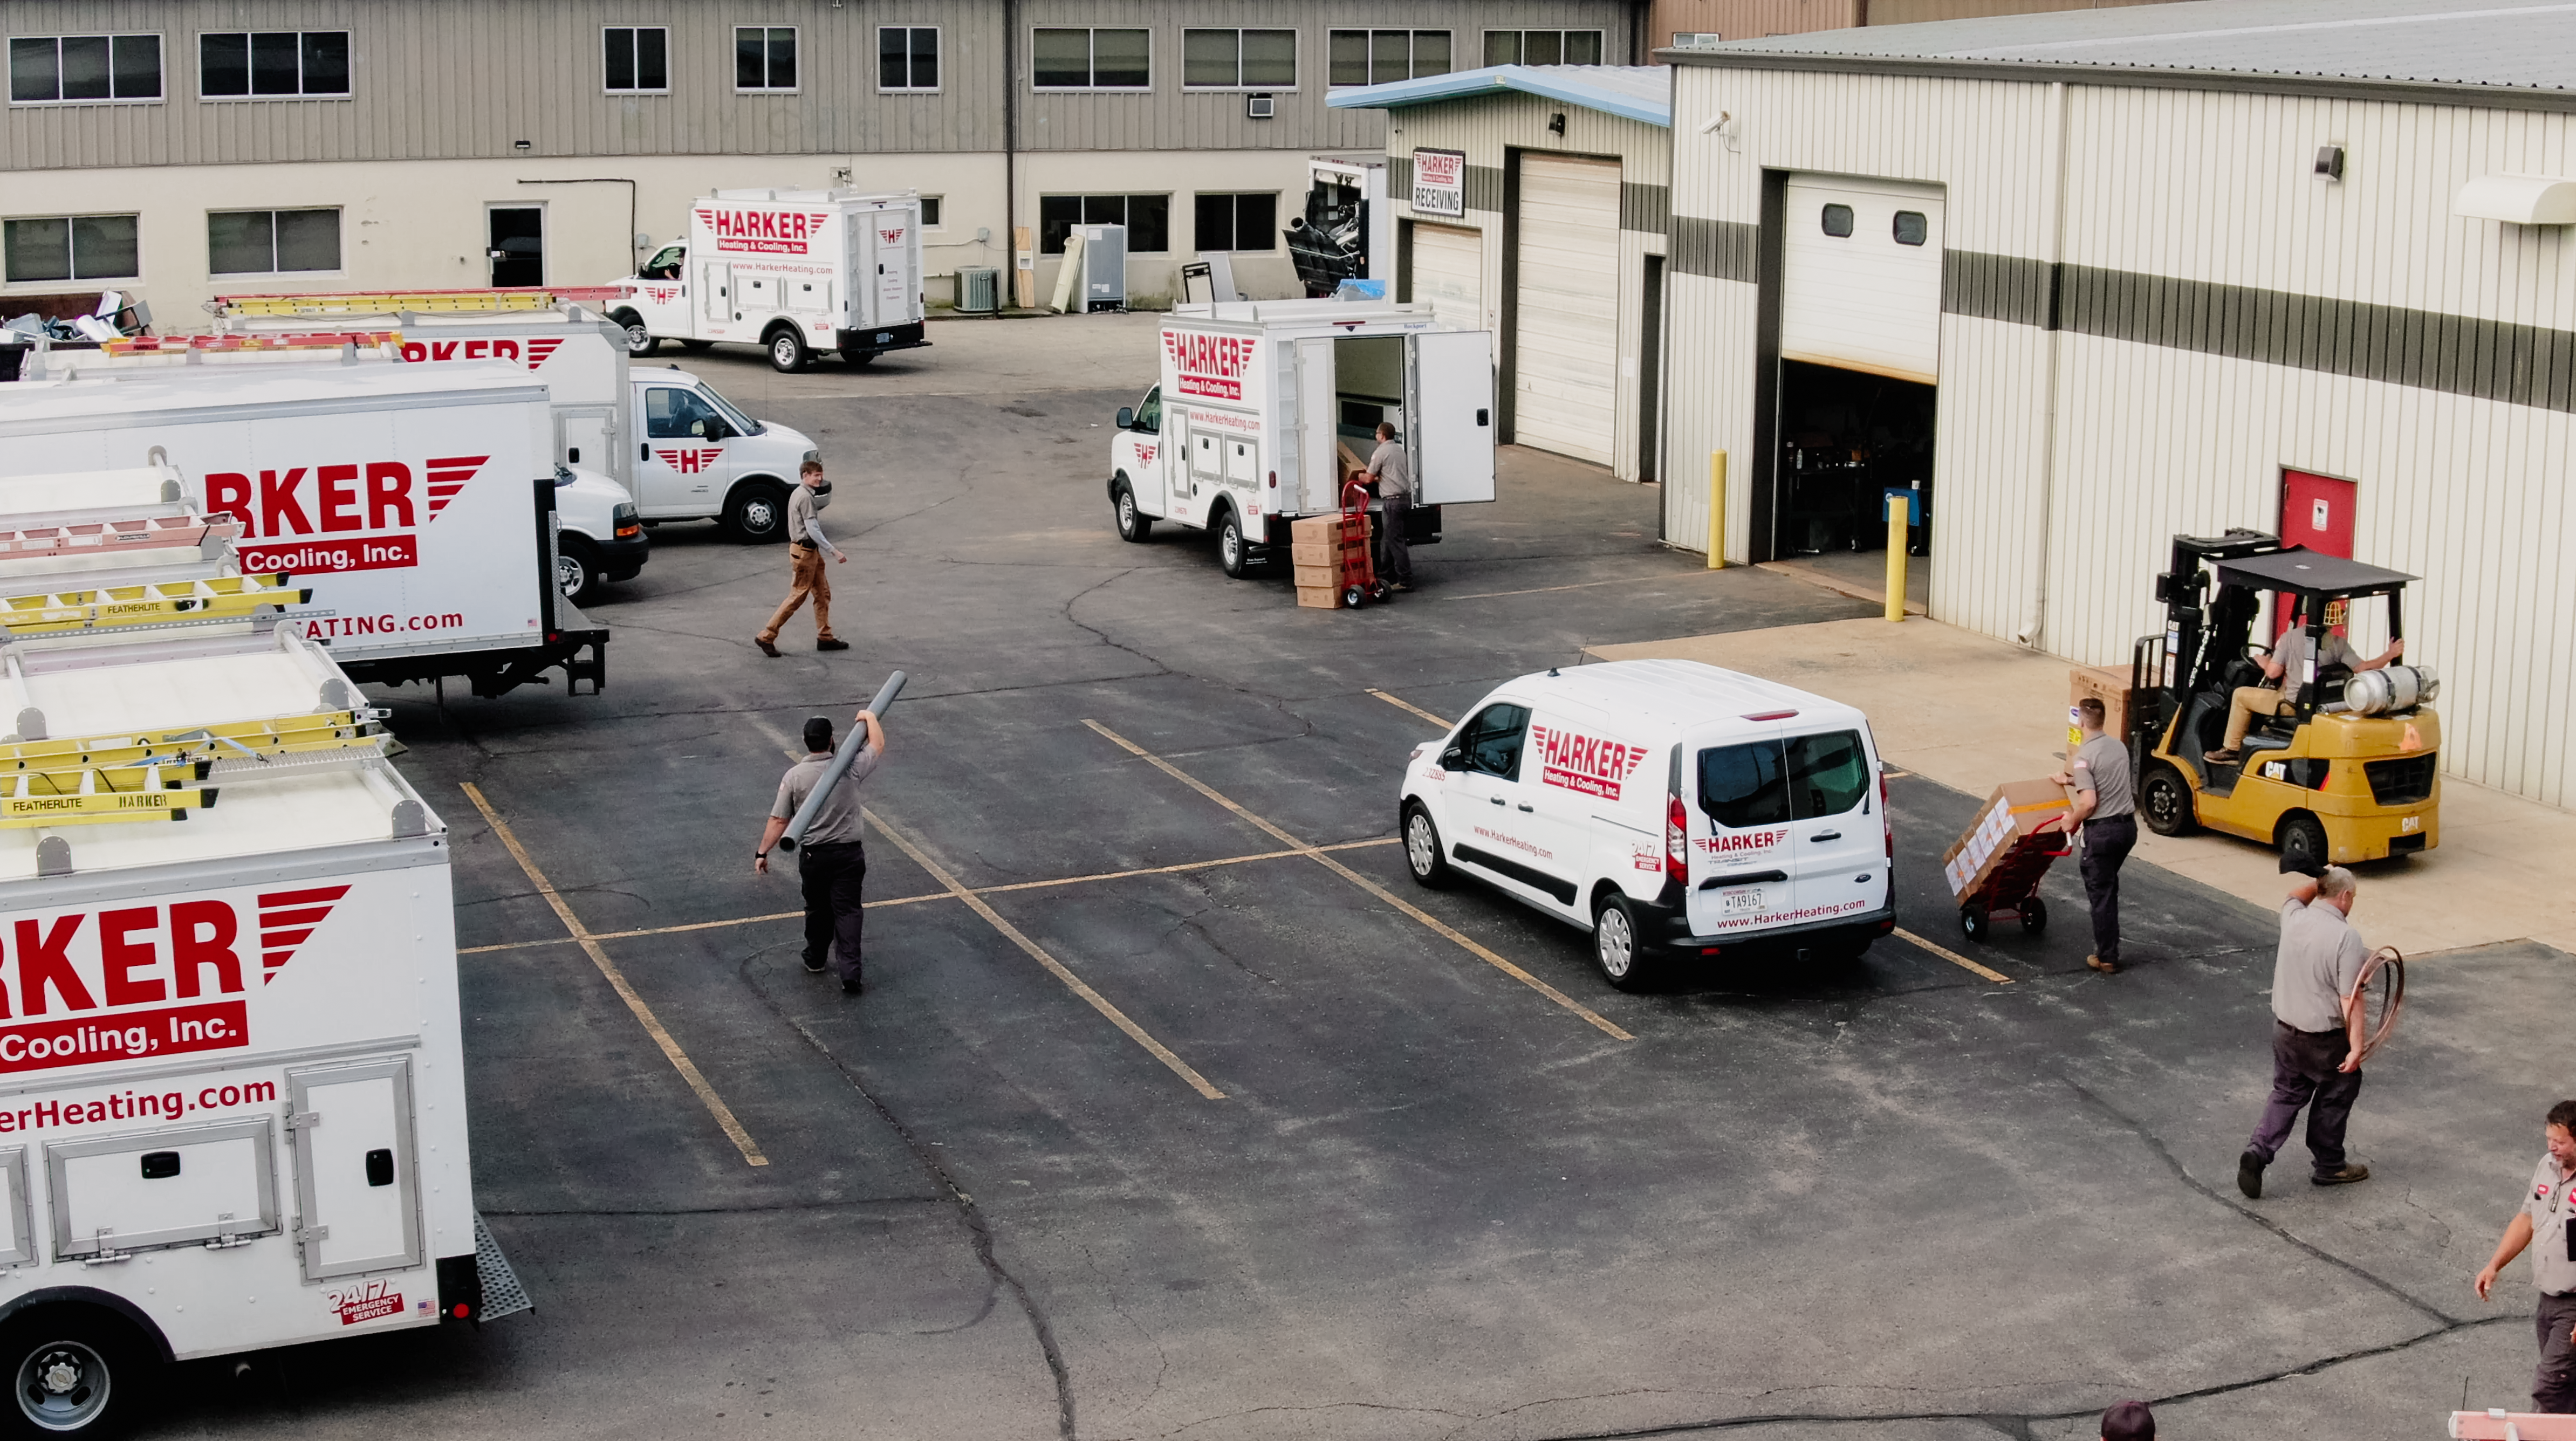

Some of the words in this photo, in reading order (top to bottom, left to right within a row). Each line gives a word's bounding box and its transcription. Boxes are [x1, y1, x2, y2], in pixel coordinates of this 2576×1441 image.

[1422, 154, 1454, 175] HARKER
[1415, 187, 1459, 211] RECEIVING
[716, 210, 807, 239] HARKER
[720, 240, 748, 251] Heating
[758, 243, 790, 253] Cooling,
[791, 244, 806, 252] Inc.
[732, 262, 833, 275] www.HarkerHeating.com
[657, 288, 666, 305] H
[1176, 333, 1241, 378] HARKER
[1180, 377, 1200, 394] Heating
[1200, 380, 1205, 392] &
[1206, 380, 1229, 397] Cooling,
[1229, 383, 1240, 396] Inc.
[1189, 410, 1260, 432] www.HarkerHeating.com
[681, 449, 699, 474] H
[245, 548, 356, 569] Cooling,
[364, 543, 410, 562] Inc.
[297, 612, 464, 639] ATING.com
[2168, 620, 2180, 632] CAT
[1544, 728, 1626, 781] HARKER
[2265, 761, 2287, 781] CAT
[1544, 769, 1569, 787] Heating
[1570, 776, 1575, 787] &
[1577, 777, 1604, 796] Cooling,
[1605, 783, 1619, 798] Inc.
[13, 798, 83, 812] FEATHERLITE
[119, 794, 167, 808] HARKER
[2402, 815, 2420, 832] CAT
[1474, 825, 1553, 860] www.HarkerHeating.com
[1708, 832, 1774, 853] HARKER
[1731, 893, 1762, 908] TA9167
[1717, 899, 1865, 929] www.HarkerHeating.com
[1, 1025, 158, 1063] Cooling,
[170, 1017, 237, 1043] Inc.
[327, 1278, 387, 1314] 24/7
[342, 1295, 399, 1316] EMERGENCY
[352, 1306, 393, 1321] SERVICE
